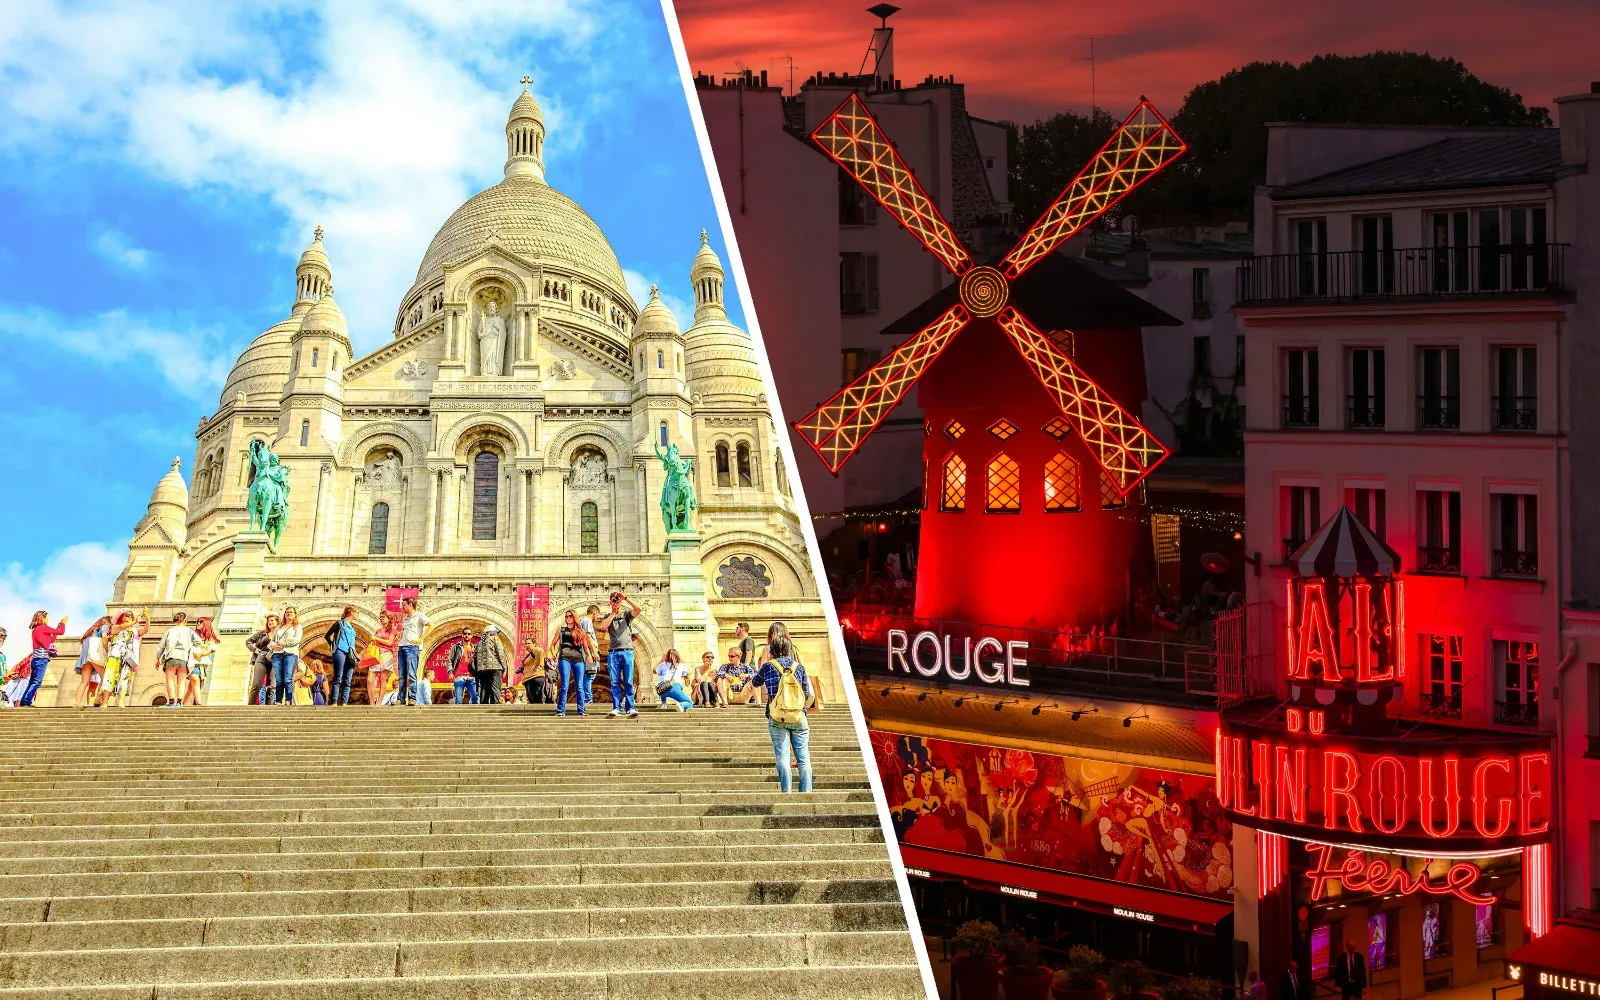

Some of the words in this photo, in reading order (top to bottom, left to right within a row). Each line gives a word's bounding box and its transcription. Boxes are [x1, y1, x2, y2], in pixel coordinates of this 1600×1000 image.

[522, 620, 542, 632] HERE
[887, 629, 1030, 686] ROUGE
[1287, 709, 1324, 735] DU
[1324, 752, 1549, 838] ROUGE
[1030, 840, 1050, 856] 1889
[1305, 842, 1498, 905] Féerie
[1000, 885, 1020, 896] MOULIN
[1020, 889, 1038, 899] ROUGE
[1113, 907, 1135, 919] MOULIN
[1135, 912, 1155, 922] ROUGE
